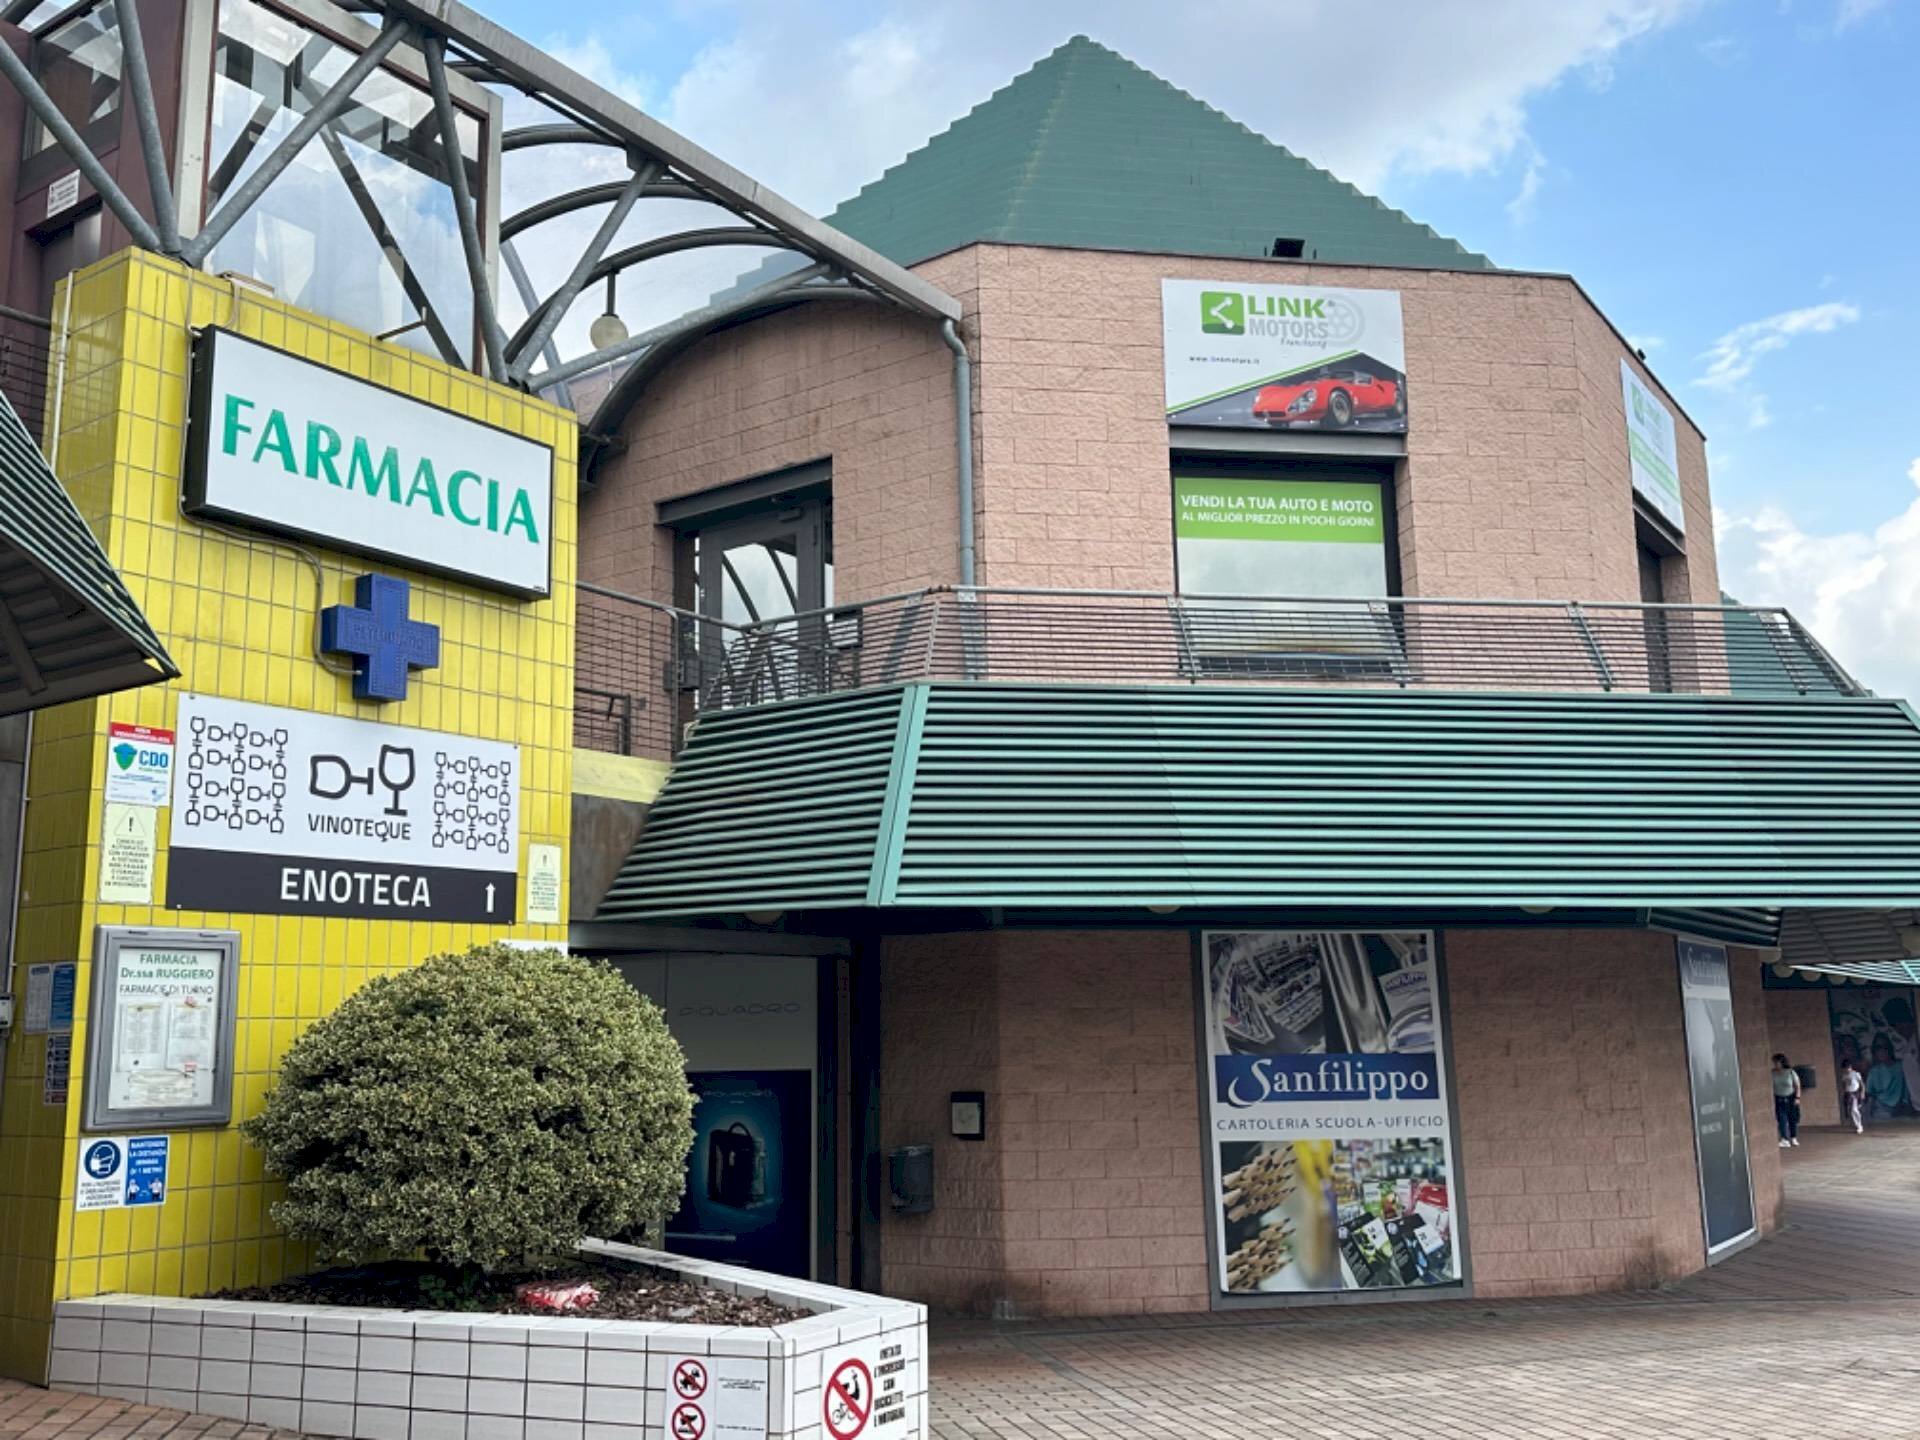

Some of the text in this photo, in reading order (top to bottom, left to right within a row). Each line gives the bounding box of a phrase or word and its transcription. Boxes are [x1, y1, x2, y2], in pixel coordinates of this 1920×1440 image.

[1248, 295, 1326, 318] LINK
[1249, 318, 1328, 340] MOTORS
[222, 394, 540, 544] FARMACIA
[1180, 495, 1374, 513] VENDI LA TUA AUTO E MOTO
[1182, 512, 1376, 527] AL MIGLIOR PREZZO IN POCHI GIORNI
[308, 813, 412, 842] VINOTEQUE
[280, 868, 431, 908] ENOTECA
[140, 954, 198, 965] FARMACIA
[121, 967, 214, 980] Dr.ssa RUGGIERO
[182, 985, 214, 994] TURNO
[1228, 1058, 1429, 1108] Sanfilippo
[1216, 1118, 1310, 1130] CARTOLERIA
